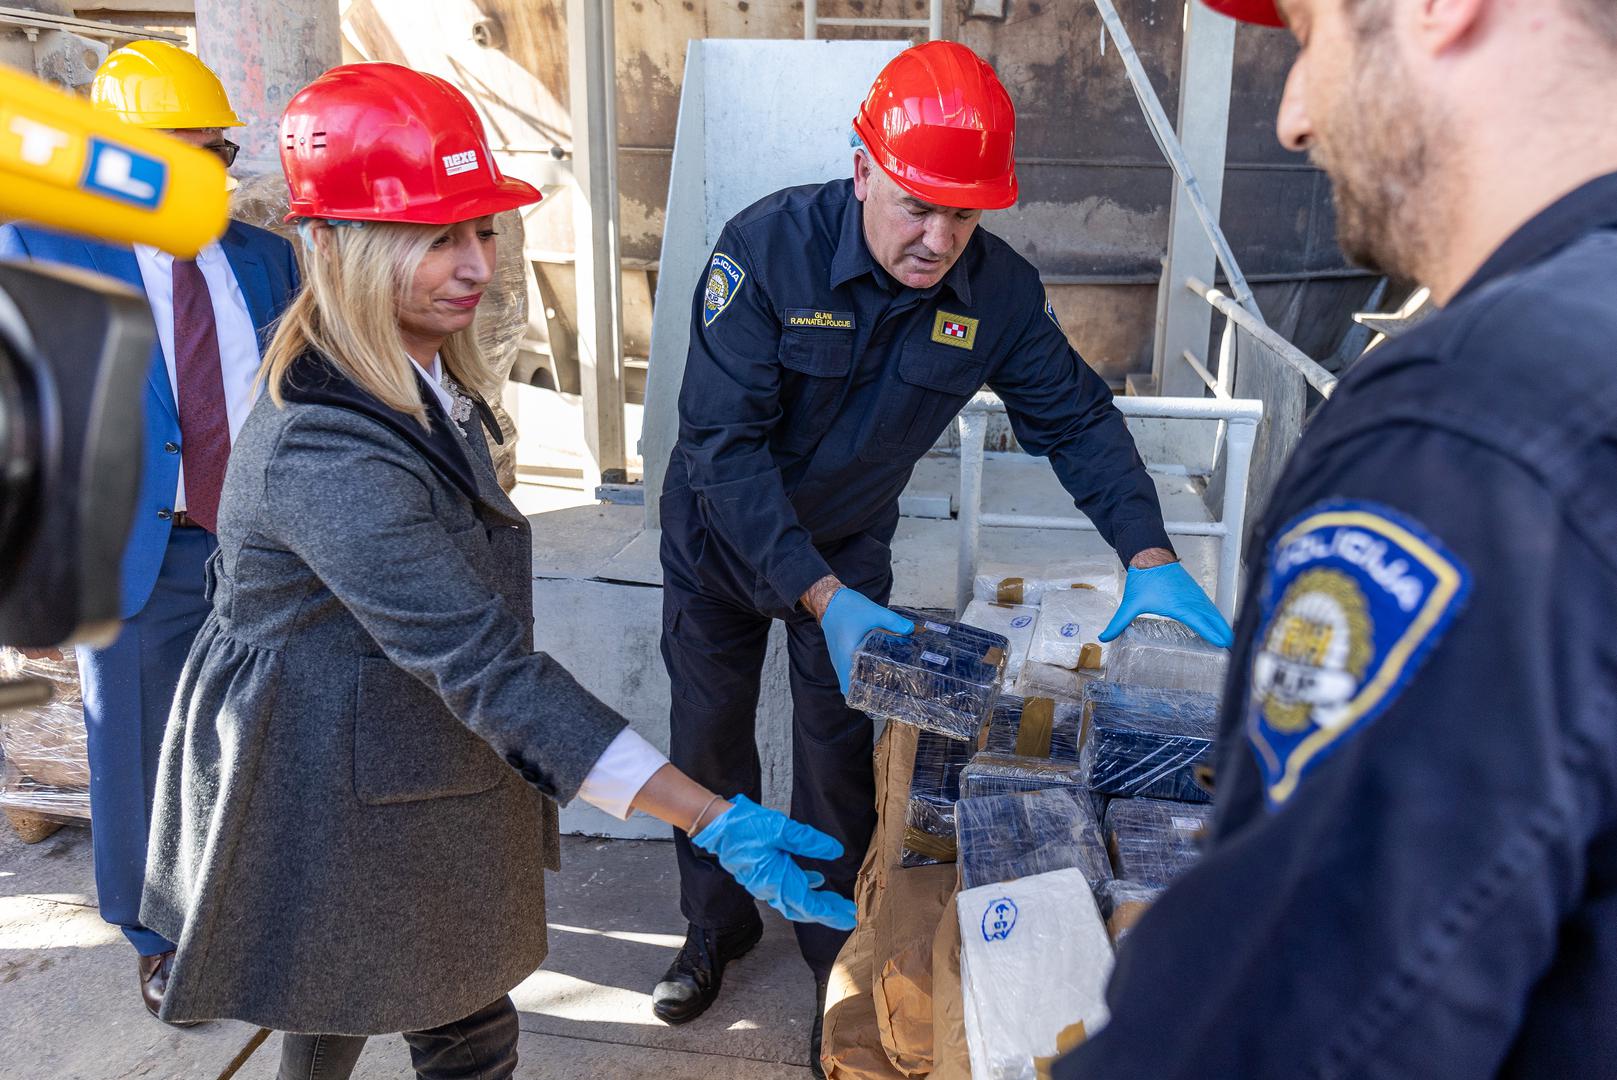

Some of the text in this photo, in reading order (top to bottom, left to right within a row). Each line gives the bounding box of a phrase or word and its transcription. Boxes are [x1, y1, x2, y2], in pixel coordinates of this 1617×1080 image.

[442, 150, 477, 168] nexe
[712, 257, 740, 283] OLICIJA
[790, 317, 826, 326] RAVNATELJ
